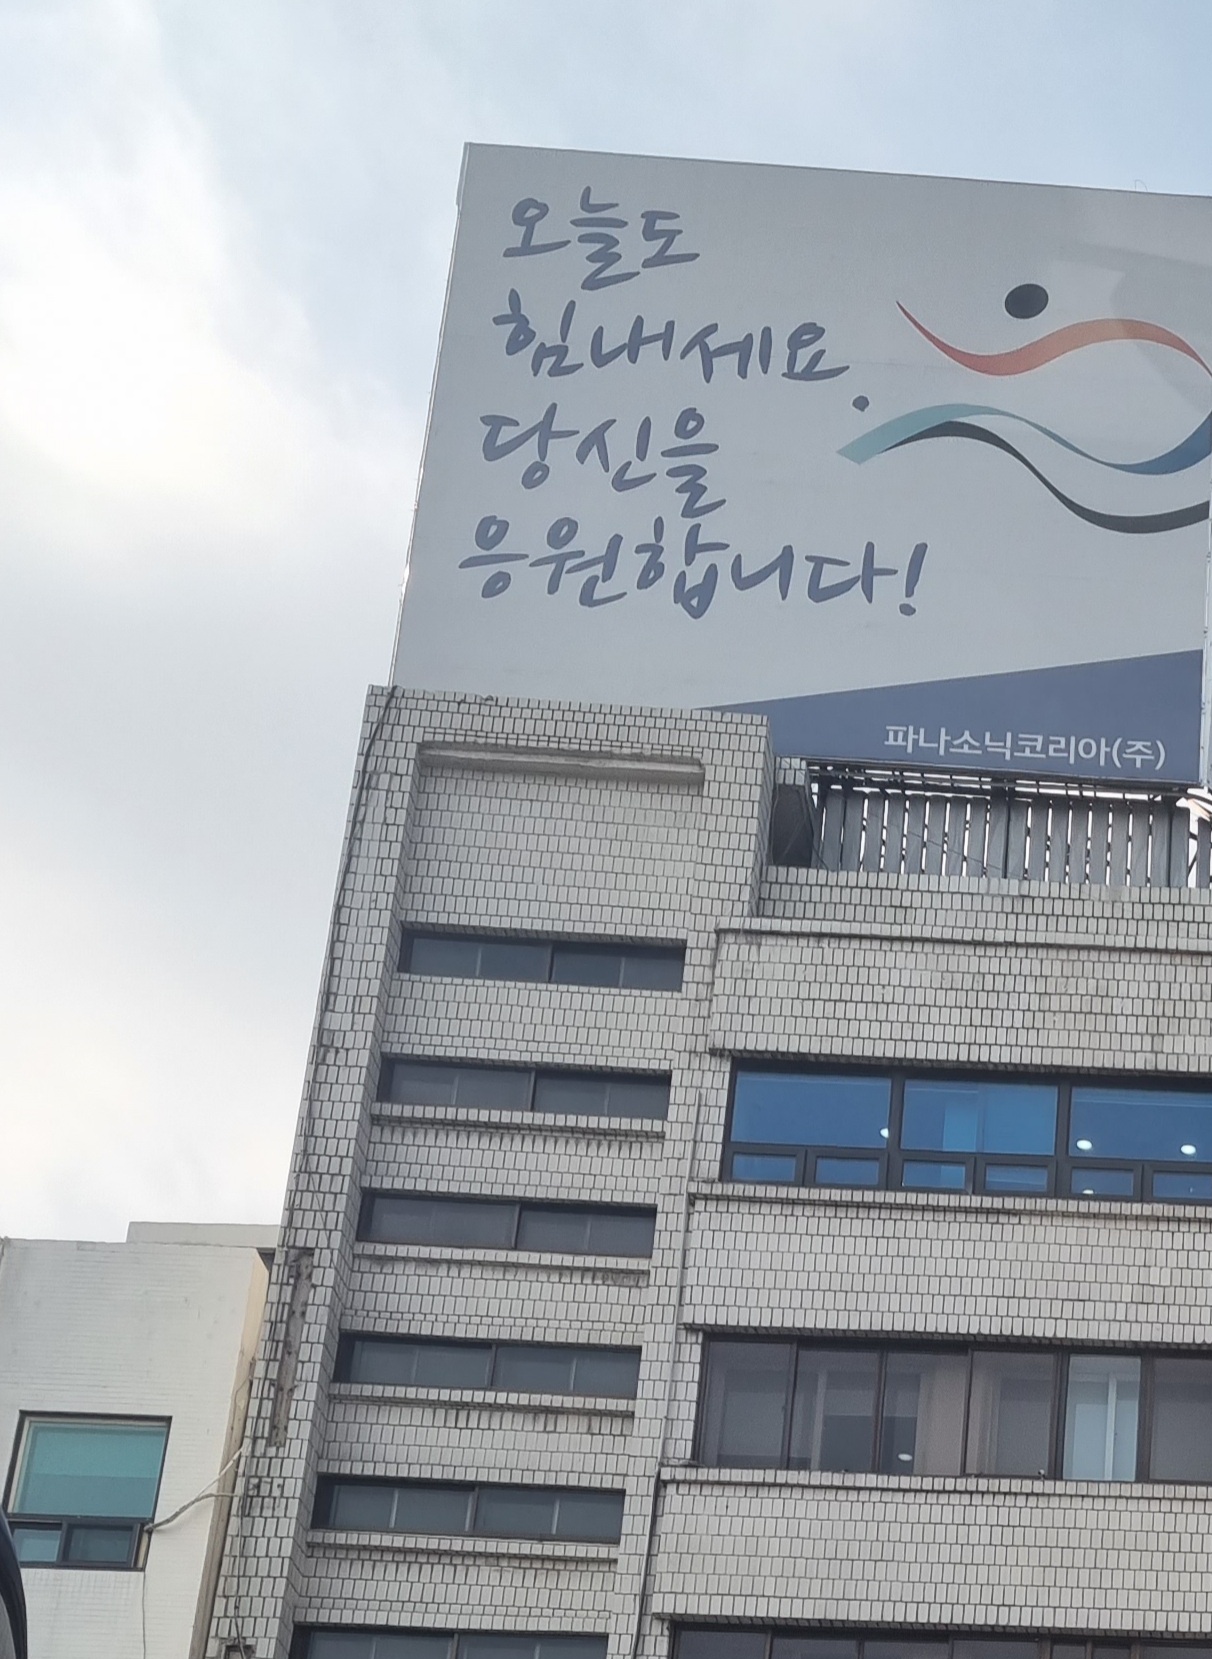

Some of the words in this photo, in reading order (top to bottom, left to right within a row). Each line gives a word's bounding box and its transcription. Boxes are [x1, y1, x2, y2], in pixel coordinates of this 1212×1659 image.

[502, 186, 700, 291] 오늘도
[479, 402, 727, 518] 당신을
[458, 515, 928, 619] 응원합니다!
[884, 724, 1167, 770] 파나소닉코리아(주)
